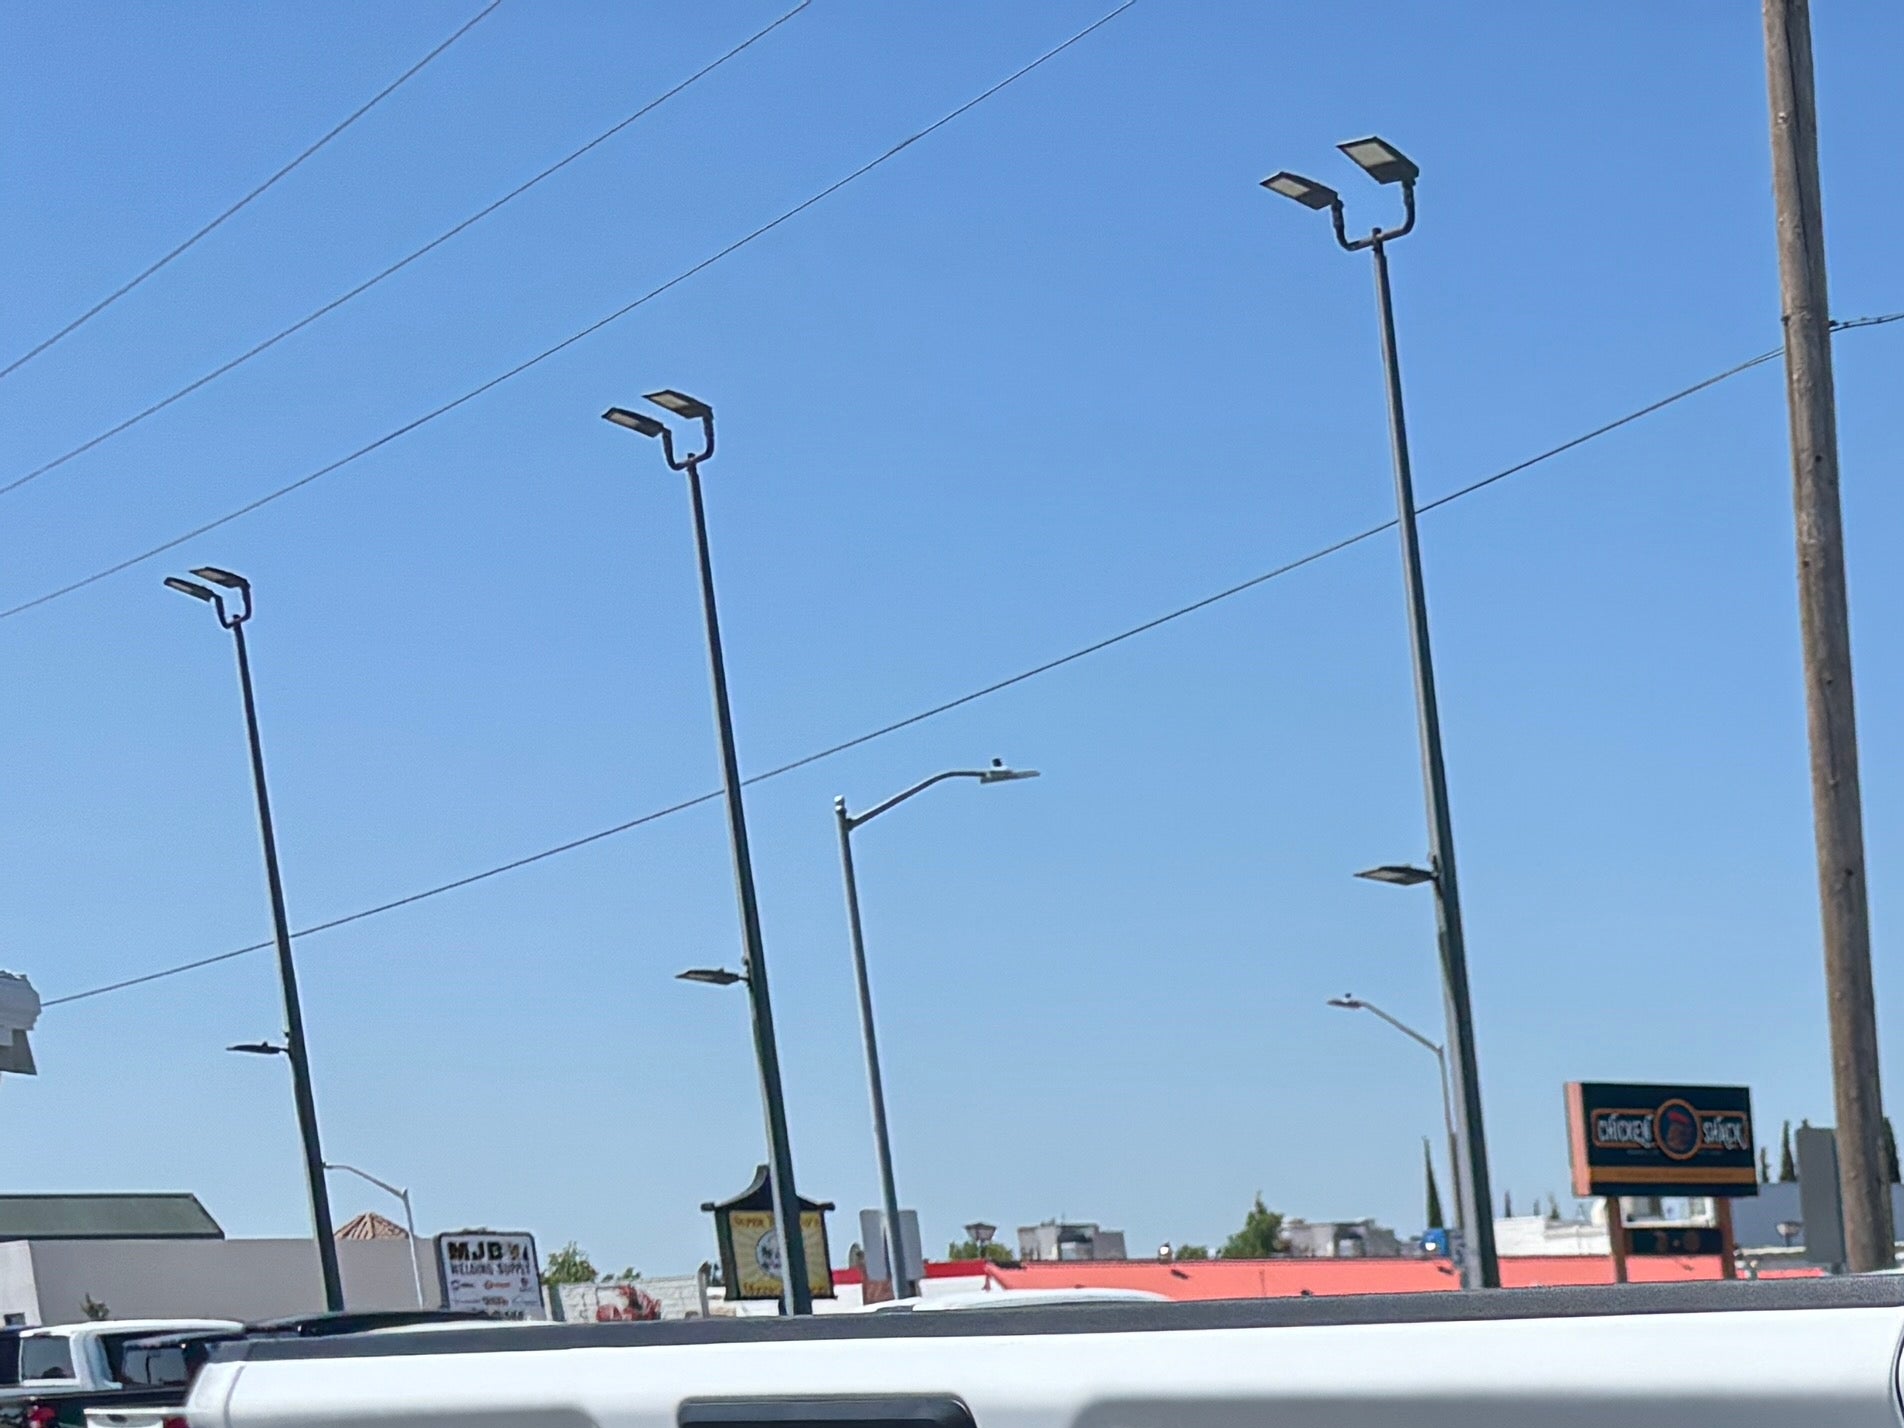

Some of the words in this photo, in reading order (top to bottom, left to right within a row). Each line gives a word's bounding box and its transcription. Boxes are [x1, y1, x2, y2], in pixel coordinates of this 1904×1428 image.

[1597, 1113, 1656, 1148] CHICKEN
[1702, 1117, 1748, 1150] SHACK
[451, 1262, 494, 1275] WELDING
[495, 1262, 531, 1276] SUPPLY
